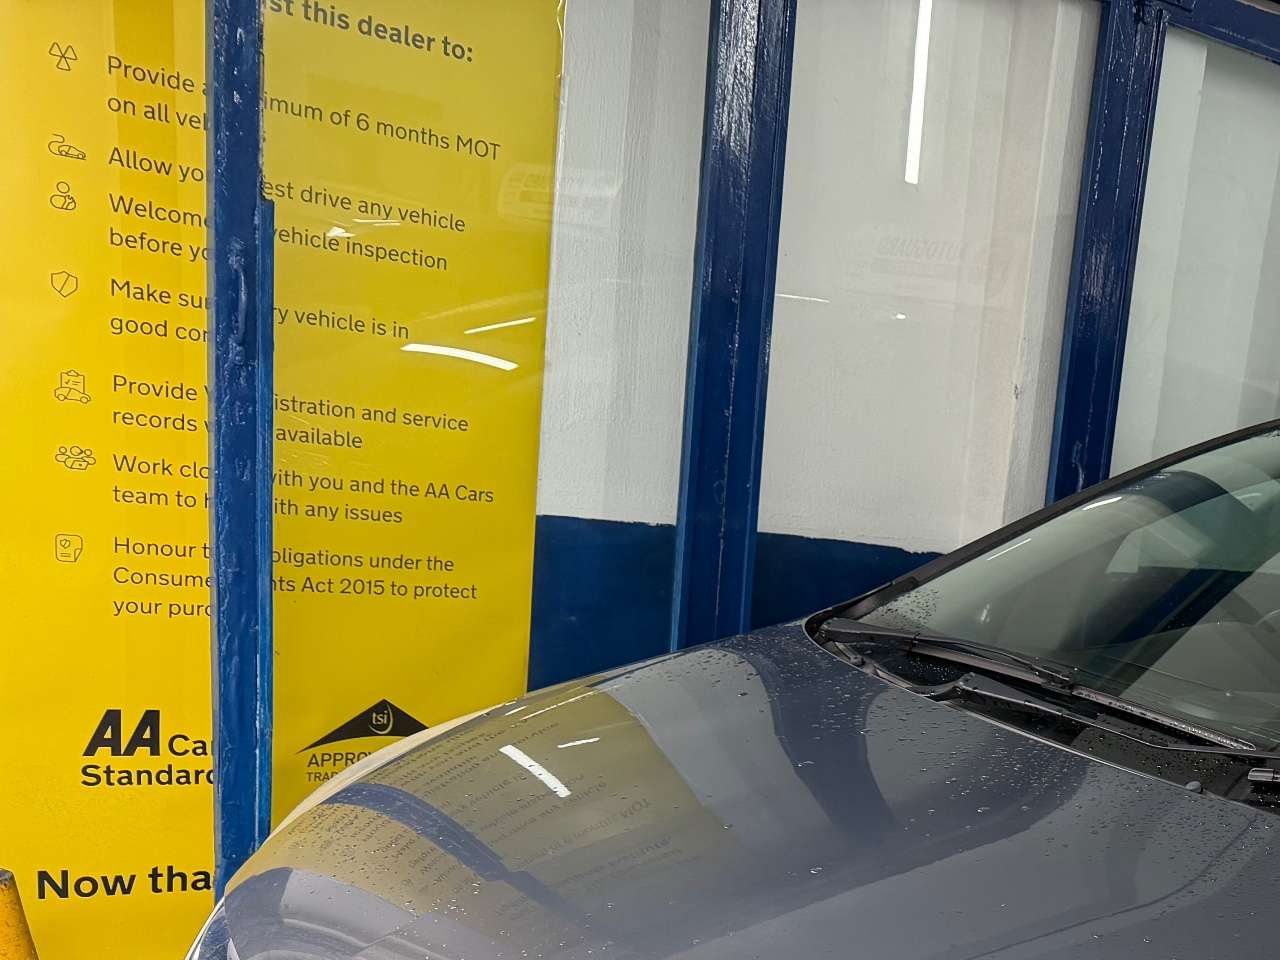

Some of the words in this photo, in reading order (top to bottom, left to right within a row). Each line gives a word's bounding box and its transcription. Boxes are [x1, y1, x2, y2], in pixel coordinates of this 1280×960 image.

[302, 2, 350, 30] this
[357, 16, 436, 51] dealer
[442, 36, 473, 62] to:
[107, 55, 195, 93] Provide
[262, 92, 323, 121] imum
[330, 109, 351, 126] of
[356, 112, 370, 131] 6
[376, 120, 450, 150] months
[456, 134, 501, 161] MOT
[107, 97, 136, 116] on
[143, 103, 170, 124] all
[108, 146, 173, 176] Allow
[179, 164, 205, 183] yo
[262, 178, 294, 200] est
[300, 185, 352, 210] drive
[358, 199, 393, 221] any
[398, 207, 466, 232] vehicle
[109, 227, 183, 257] before
[189, 245, 209, 262] yo
[346, 237, 447, 270] inspection
[111, 278, 172, 305] Make
[110, 317, 168, 338] good
[295, 309, 366, 333] vehicle
[372, 318, 386, 336] is
[393, 320, 409, 339] in
[113, 375, 198, 402] Provide
[274, 393, 355, 419] istration
[361, 406, 396, 424] and
[402, 412, 469, 432] service
[112, 409, 199, 432] records
[275, 427, 363, 448] available
[112, 454, 173, 477] Work
[179, 462, 211, 480] clo
[309, 475, 344, 492] you
[350, 478, 385, 495] and
[390, 480, 420, 497] the
[424, 483, 450, 500] AA
[455, 485, 494, 503] Cars
[112, 486, 170, 506] team
[175, 491, 198, 509] to
[274, 498, 299, 516] ith
[305, 503, 340, 522] any
[345, 504, 403, 523] issues
[113, 536, 197, 559] Honour
[369, 554, 422, 571] under
[426, 556, 454, 572] the
[301, 577, 334, 594] Act
[340, 578, 385, 596] 2015
[390, 581, 408, 597] to
[413, 583, 478, 600] protect
[113, 600, 163, 618] your
[82, 709, 161, 757] AA
[371, 710, 388, 725] tsi
[307, 751, 376, 768] APPRO
[37, 869, 136, 900] Now
[148, 865, 213, 894] tha
